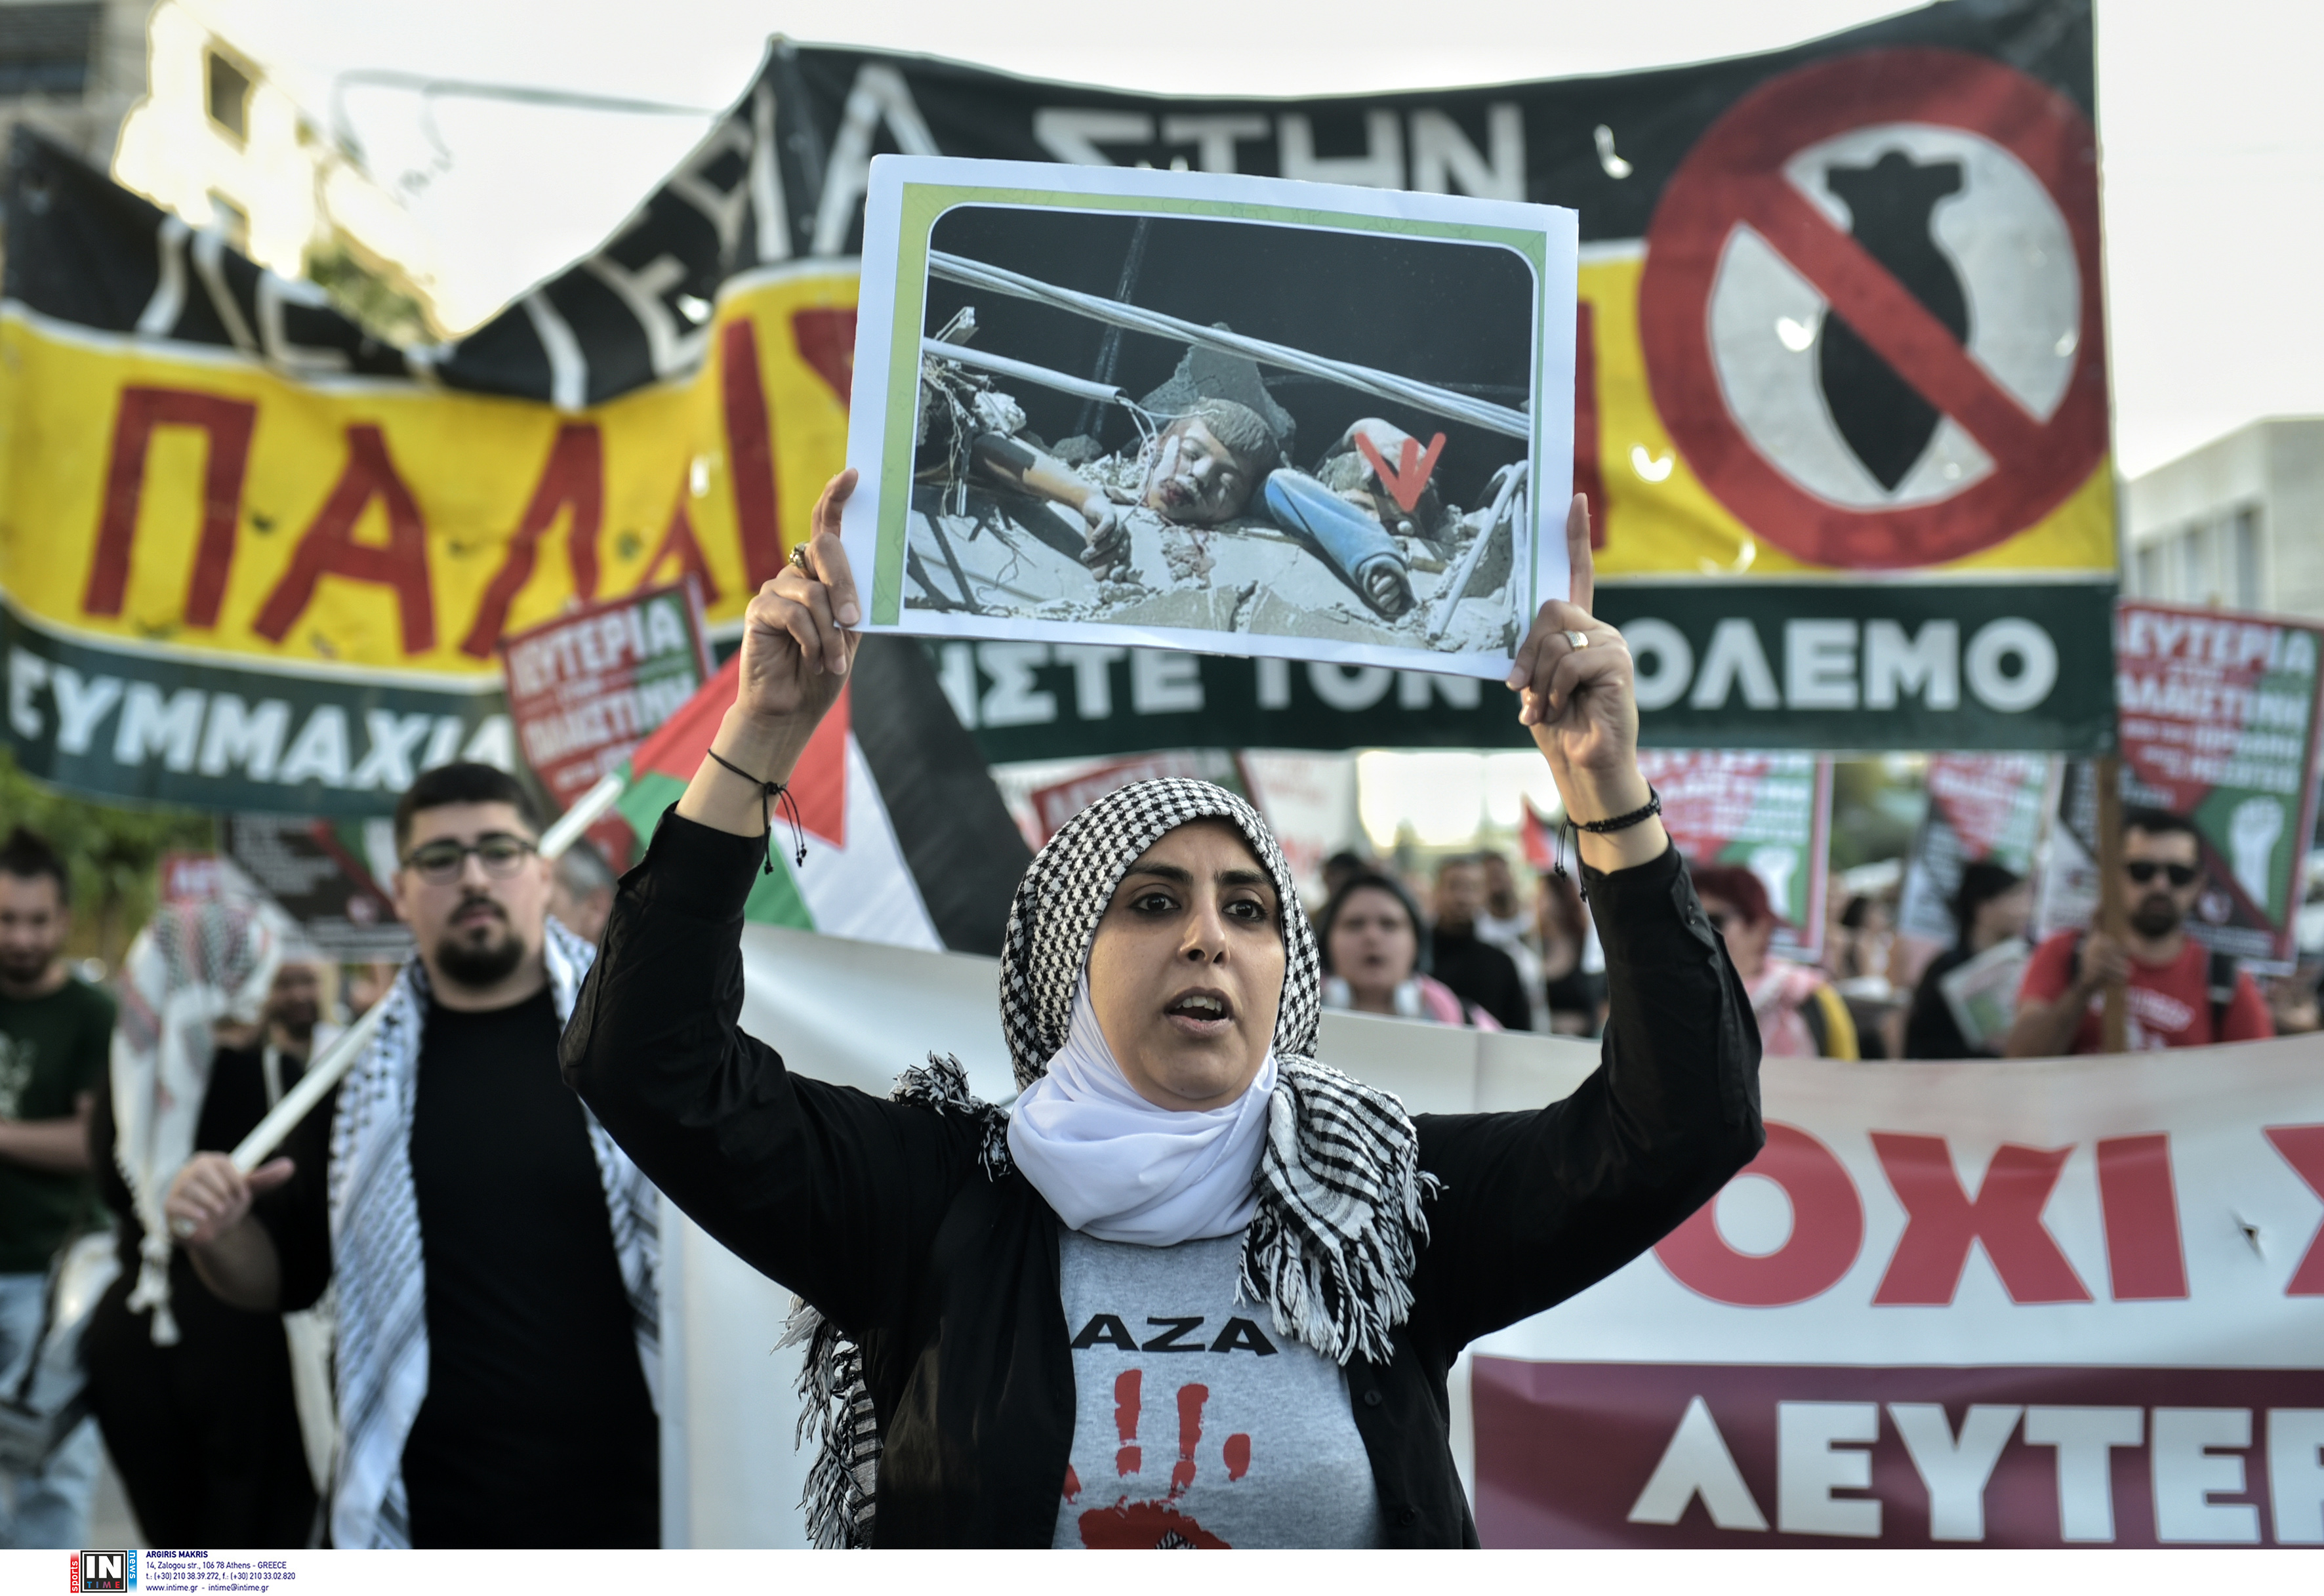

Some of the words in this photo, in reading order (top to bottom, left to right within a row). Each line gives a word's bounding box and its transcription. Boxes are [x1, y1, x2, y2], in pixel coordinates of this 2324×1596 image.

[1630, 615, 2060, 713] ΟΛΕΜΟ
[1651, 1118, 2191, 1308] ΟΧΙ
[1070, 1313, 1278, 1357] AZA
